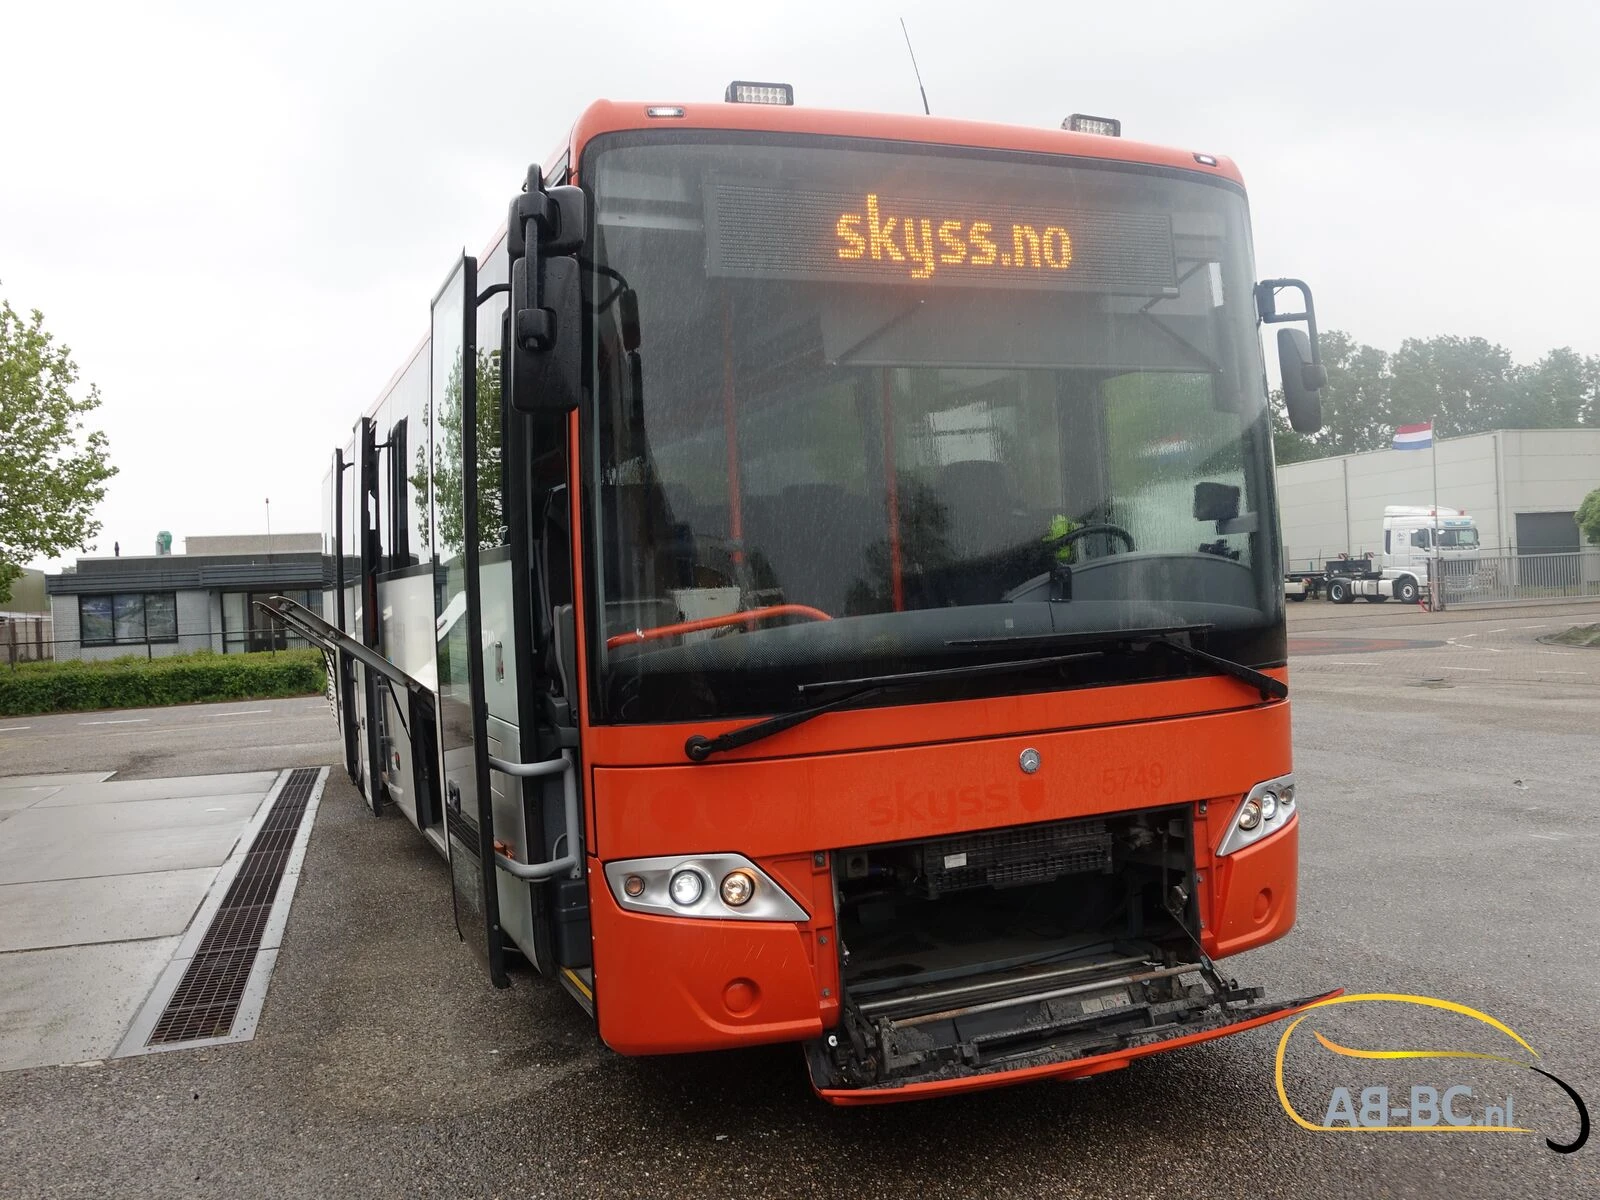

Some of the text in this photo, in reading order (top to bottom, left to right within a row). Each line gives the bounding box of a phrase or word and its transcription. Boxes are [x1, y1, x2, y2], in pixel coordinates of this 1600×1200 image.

[835, 193, 1073, 279] skyss.no
[1101, 761, 1164, 796] 5749
[867, 779, 1011, 829] skyss
